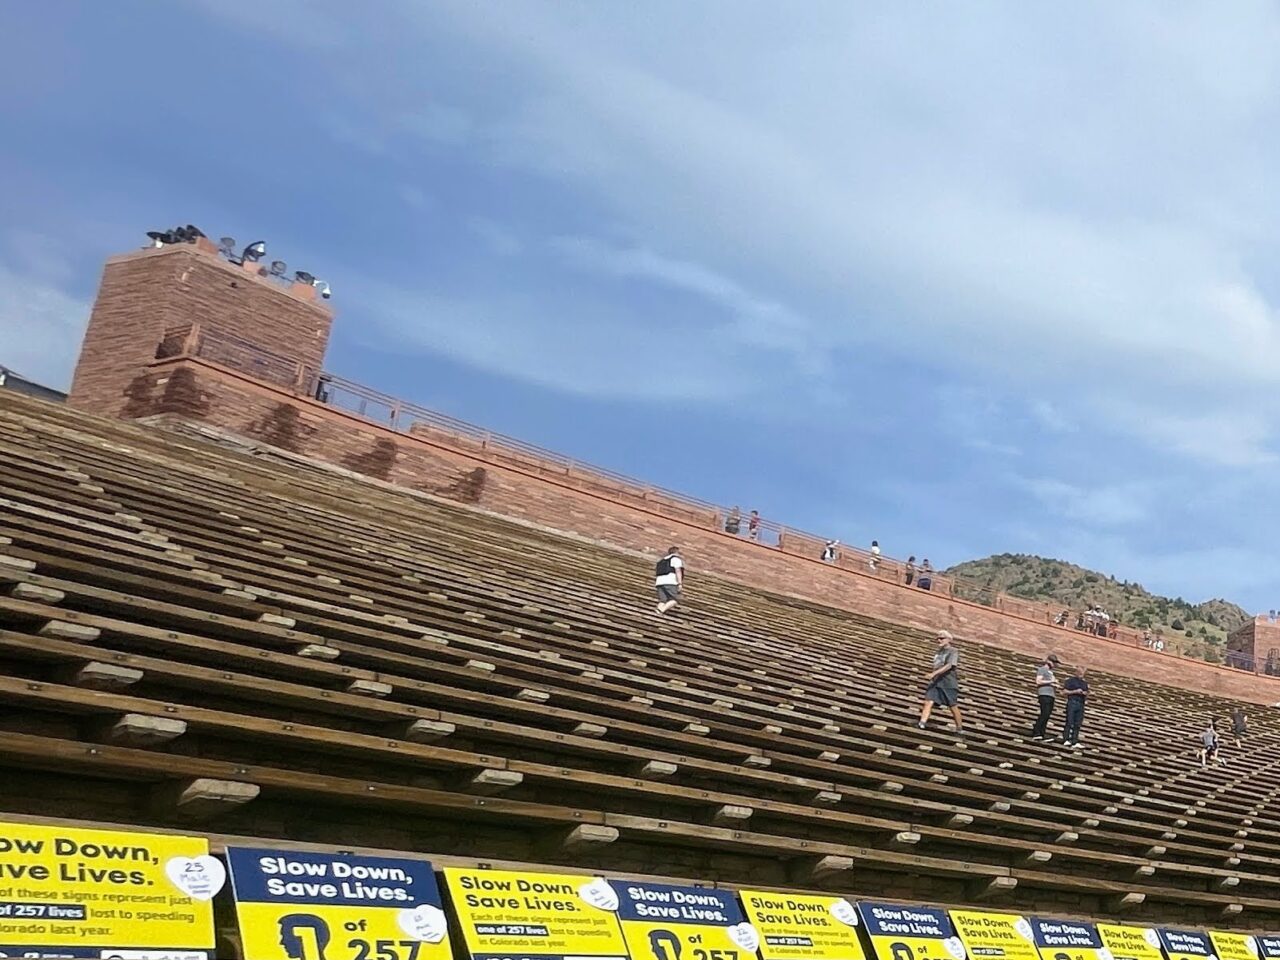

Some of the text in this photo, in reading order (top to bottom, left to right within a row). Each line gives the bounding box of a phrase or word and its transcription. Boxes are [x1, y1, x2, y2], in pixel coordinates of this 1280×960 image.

[55, 839, 159, 865] Down,
[60, 863, 154, 886] Lives.
[185, 863, 204, 872] 25
[259, 857, 413, 884] Slow Down,
[267, 878, 414, 901] Save Lives.
[460, 876, 579, 897] Slow Down,
[17, 889, 57, 899] these
[62, 891, 99, 902] signs
[104, 894, 166, 905] represent
[170, 895, 192, 906] just
[467, 895, 520, 908] Save
[526, 896, 581, 911] Lives.
[628, 887, 670, 903] Slow
[672, 891, 724, 908] Down,
[751, 897, 829, 915] Slow Down,
[15, 905, 44, 916] 257
[48, 907, 83, 918] lives
[91, 909, 115, 918] lost
[120, 910, 132, 919] to
[137, 911, 194, 923] speeding
[635, 904, 727, 921] Save Lives.
[756, 912, 831, 926] Save Lives.
[872, 908, 939, 924] Slow Down,
[51, 924, 75, 935] last
[80, 927, 113, 937] year.
[344, 920, 367, 932] of
[879, 921, 943, 935] Save Lives.
[688, 934, 702, 943] of
